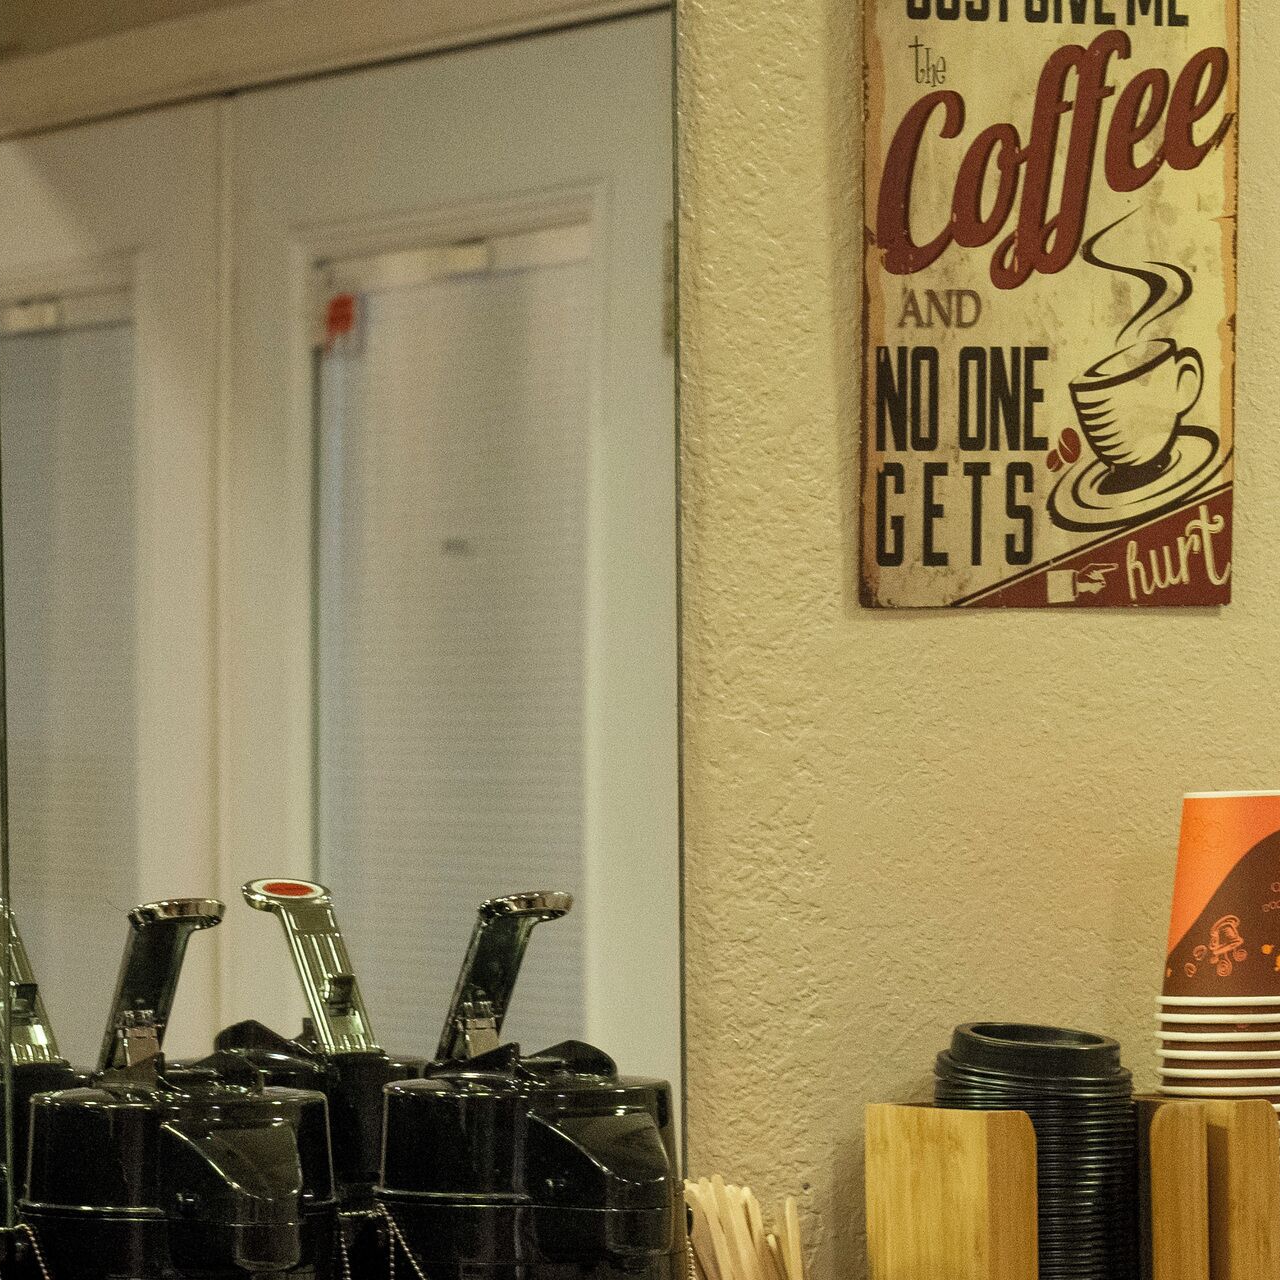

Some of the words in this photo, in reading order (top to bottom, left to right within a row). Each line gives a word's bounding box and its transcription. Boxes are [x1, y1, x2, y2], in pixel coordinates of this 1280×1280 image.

[908, 35, 947, 88] the
[876, 29, 1236, 290] Coffee
[898, 288, 982, 330] AND
[875, 345, 939, 452] NO
[958, 345, 1049, 452] ONE
[875, 461, 1035, 568] GETS
[1125, 504, 1231, 600] hurt
